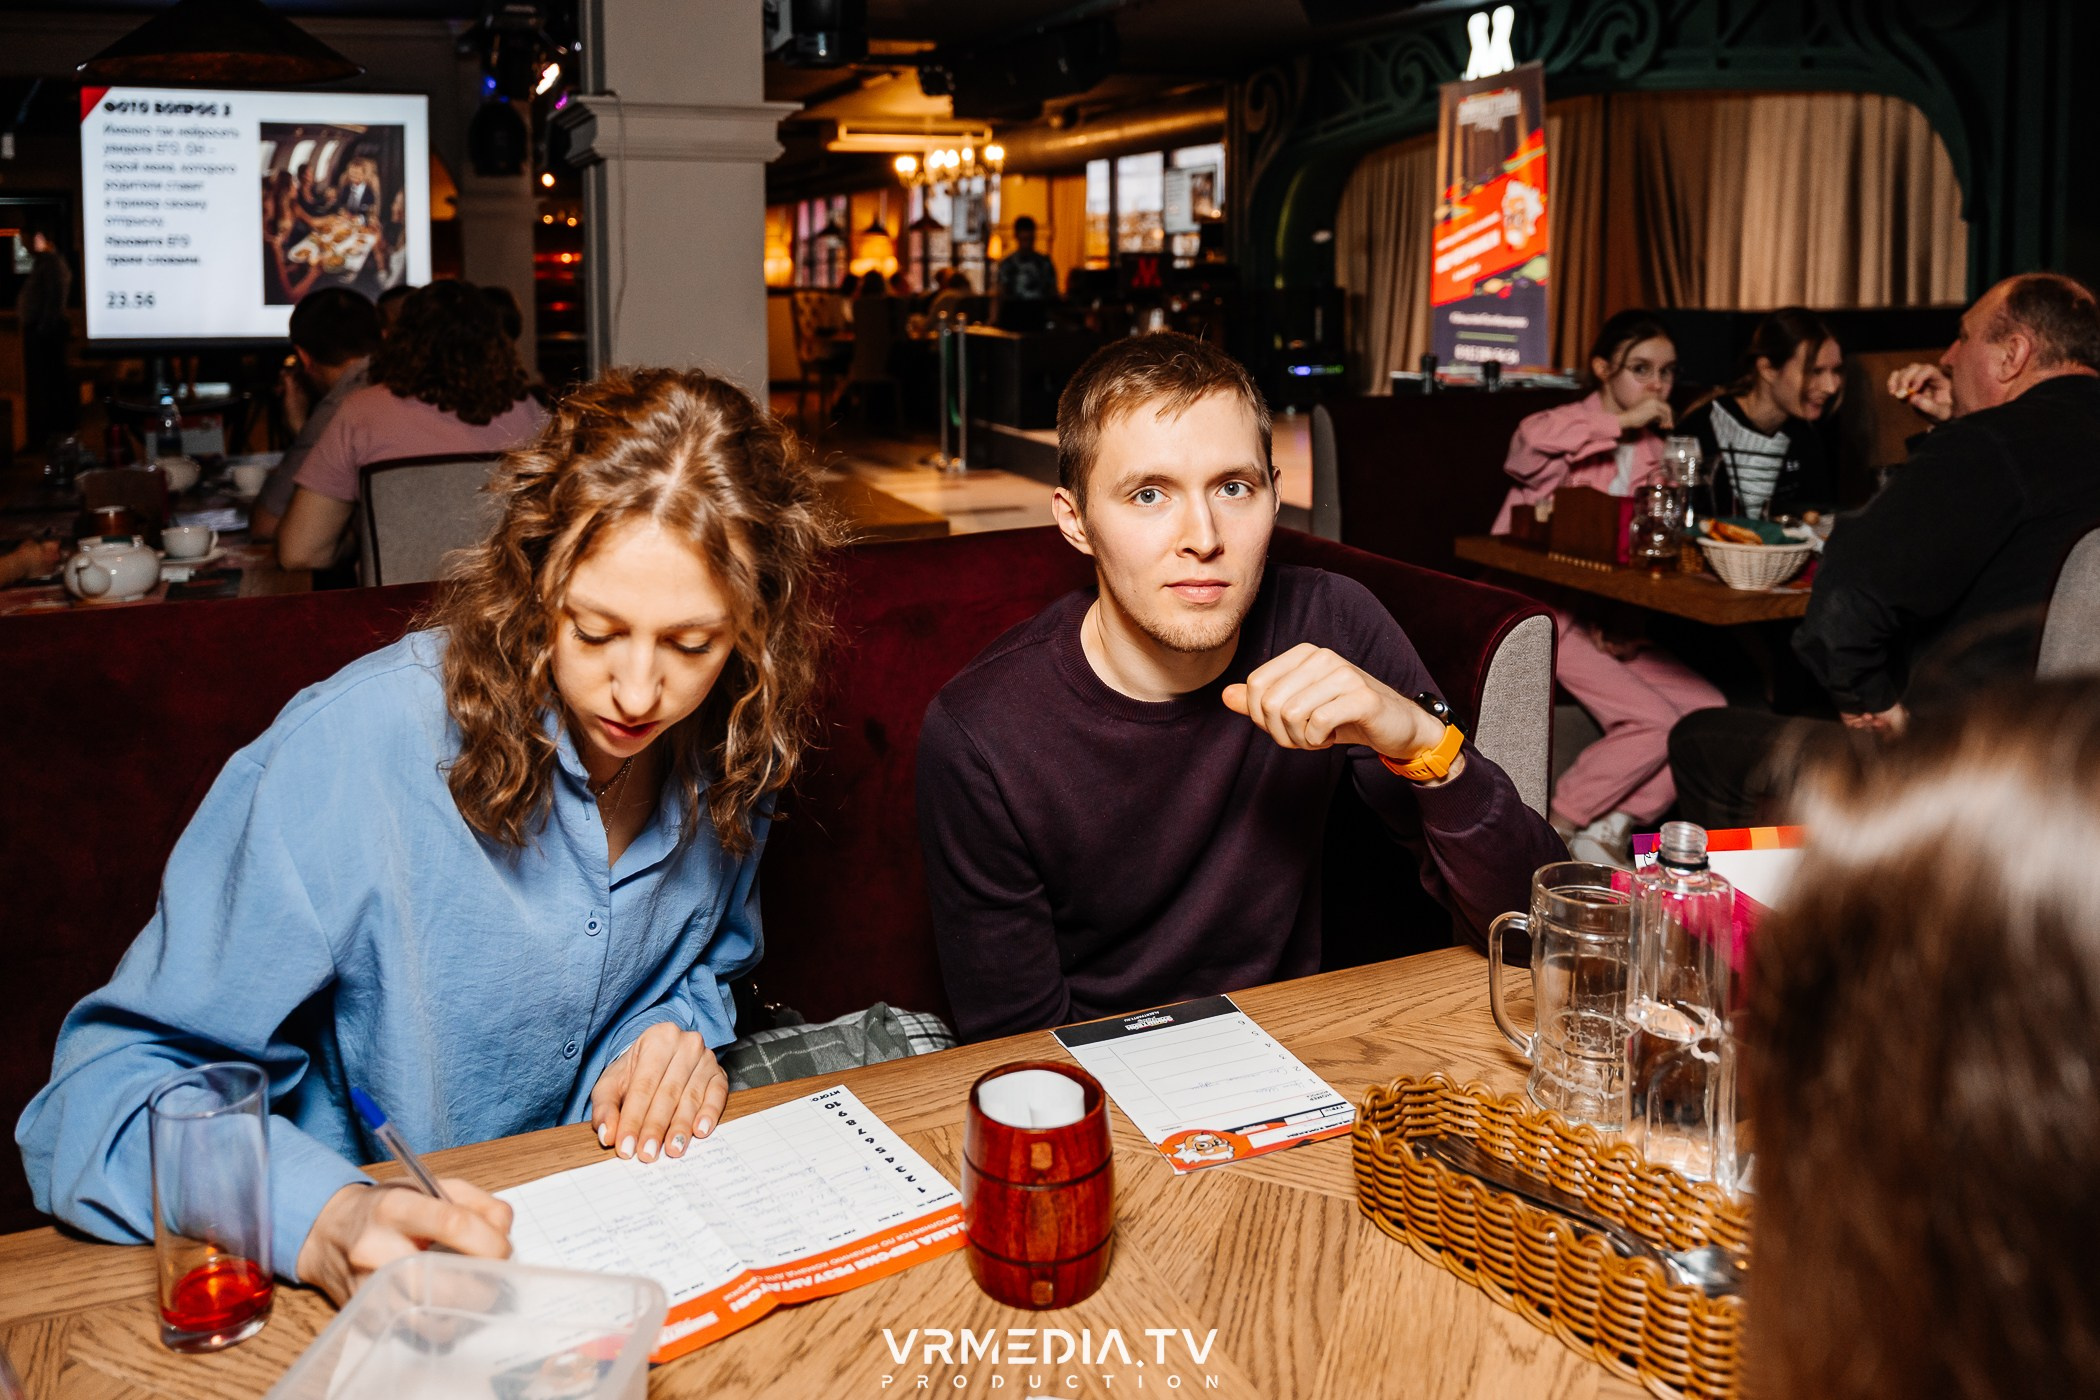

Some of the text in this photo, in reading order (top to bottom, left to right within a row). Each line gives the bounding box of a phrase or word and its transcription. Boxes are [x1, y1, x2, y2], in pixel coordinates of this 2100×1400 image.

[824, 1101, 842, 1110] 10
[857, 1128, 867, 1136] 7
[875, 1146, 887, 1154] 5
[884, 1156, 895, 1164] 4
[895, 1165, 907, 1173] 3
[904, 1174, 917, 1183] 2
